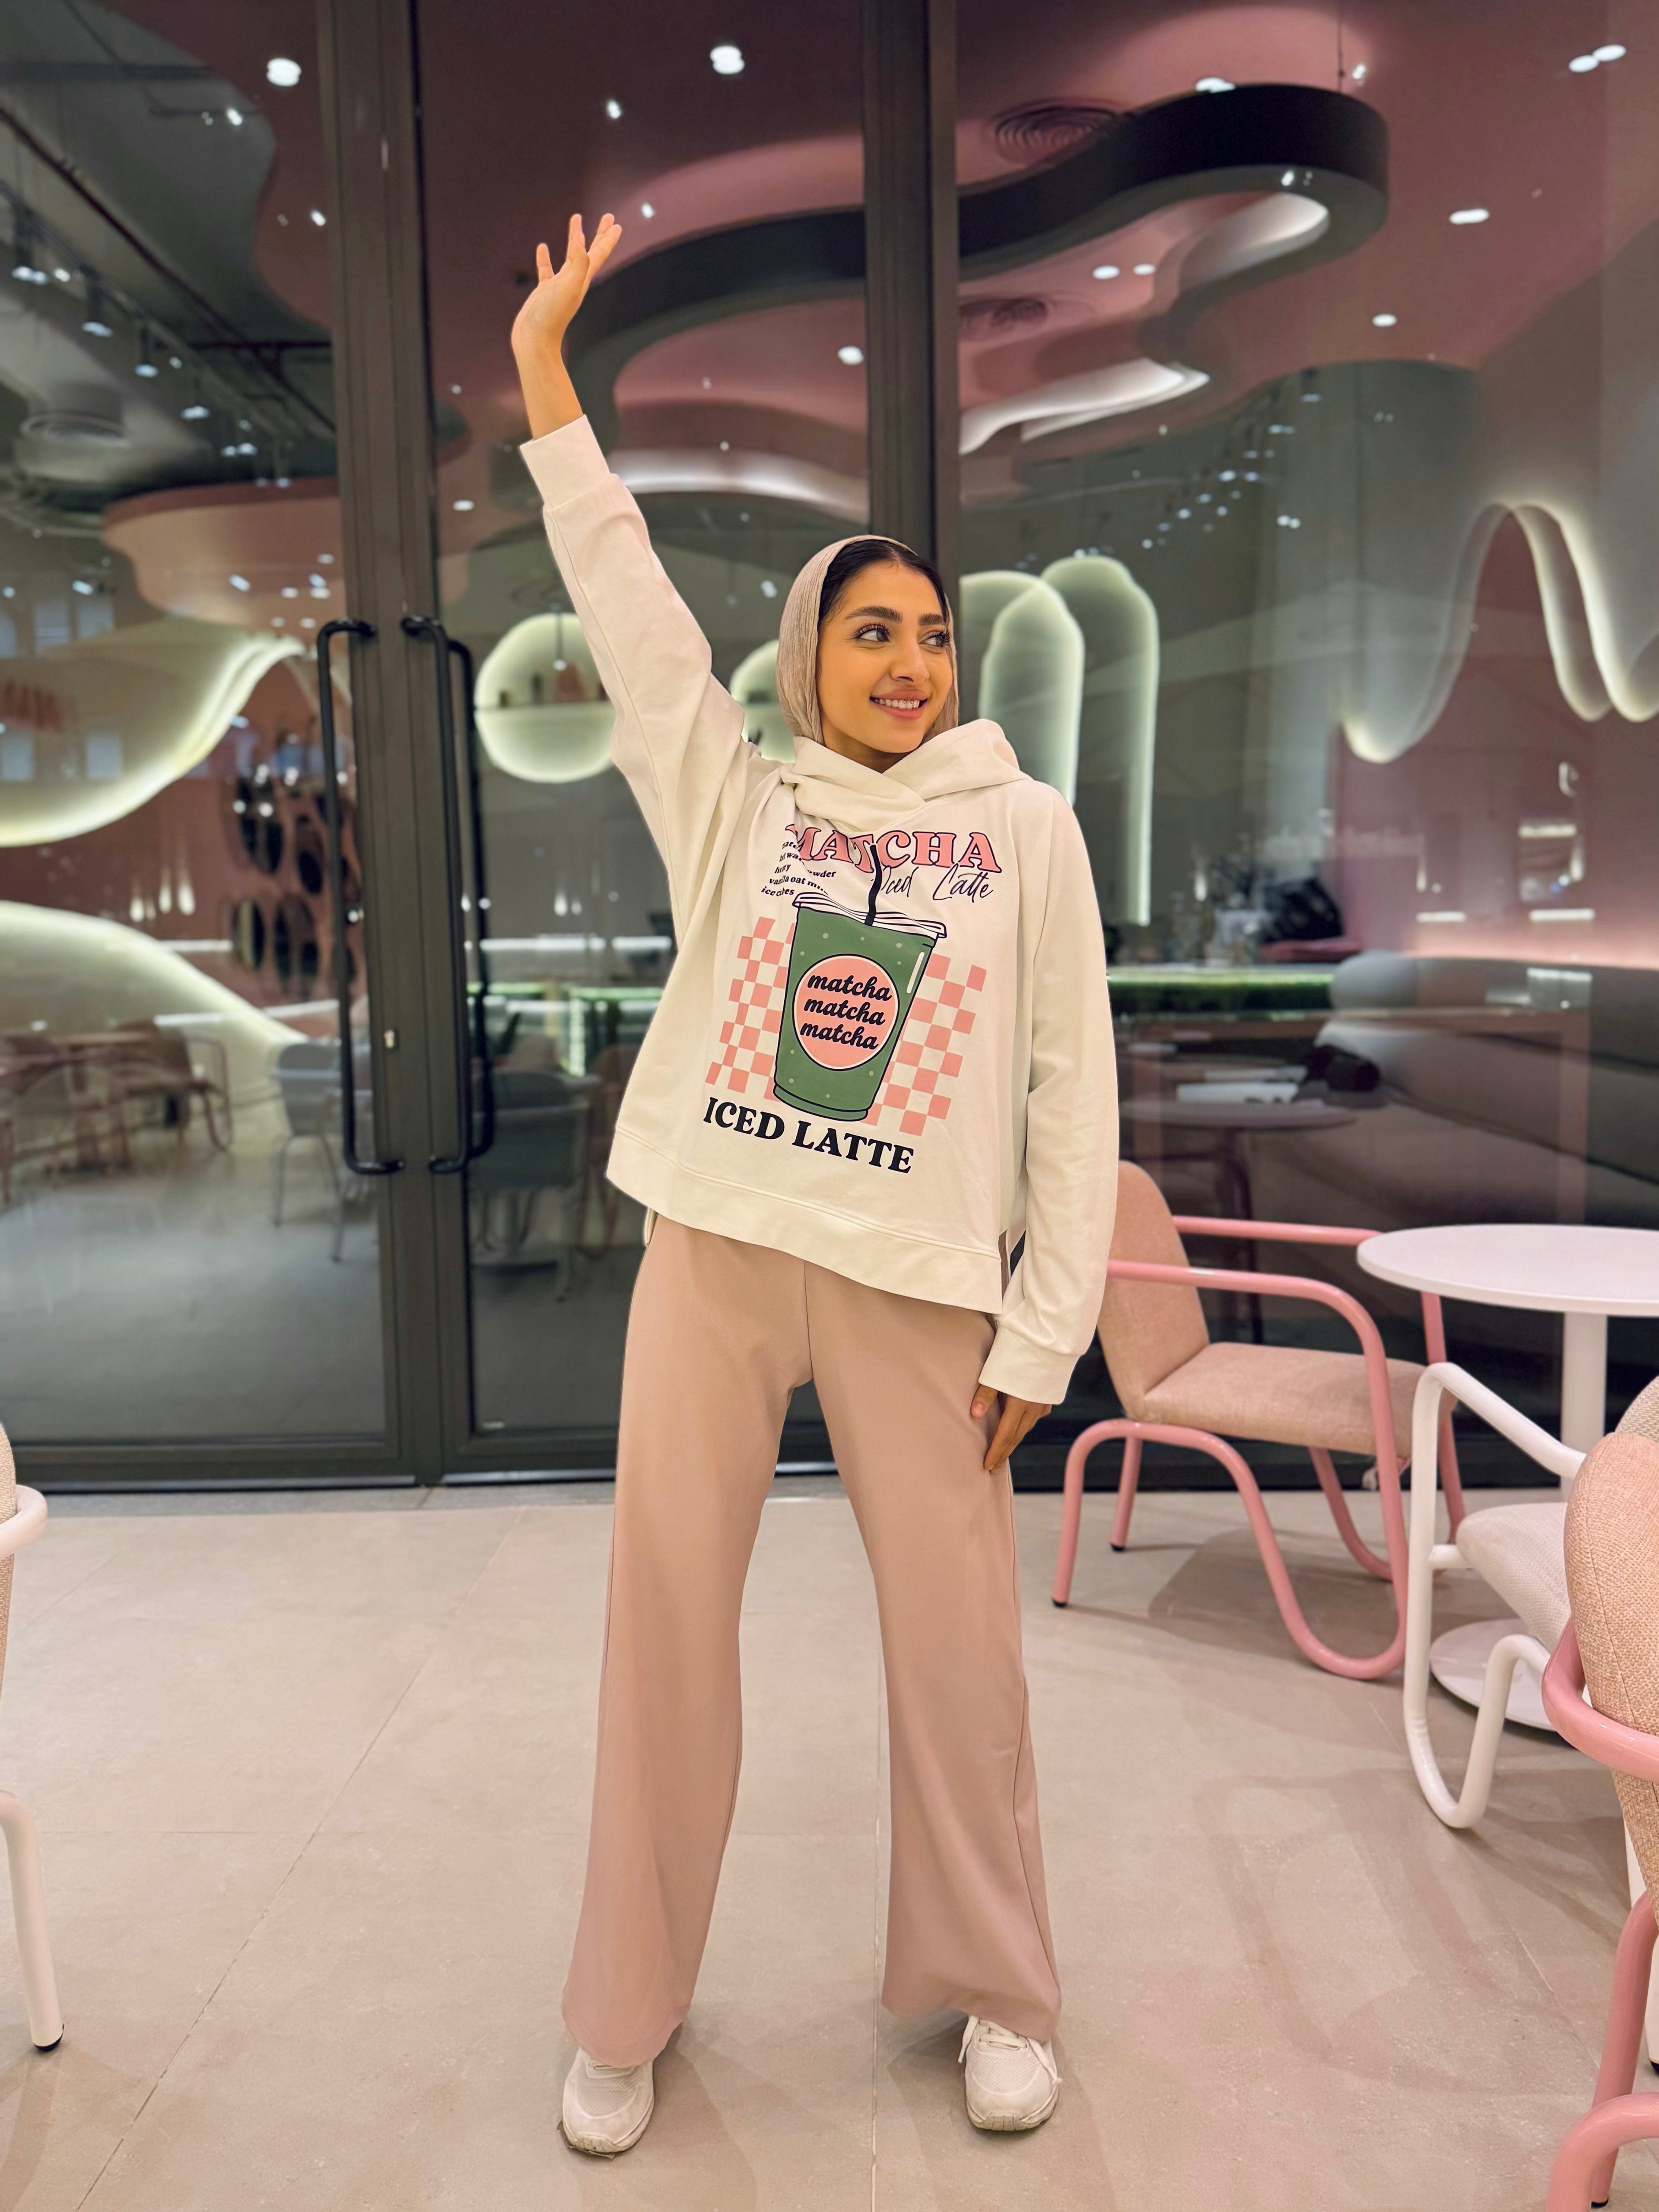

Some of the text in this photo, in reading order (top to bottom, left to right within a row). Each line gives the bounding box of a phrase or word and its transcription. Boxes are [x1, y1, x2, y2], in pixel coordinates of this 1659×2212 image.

[784, 823, 1002, 873] MATCHA
[761, 886, 776, 896] ice
[932, 863, 994, 903] Latte
[807, 975, 893, 1001] matcha
[804, 998, 886, 1026] matcha
[799, 1022, 880, 1050] matcha
[703, 1097, 914, 1174] ICED LATTE
